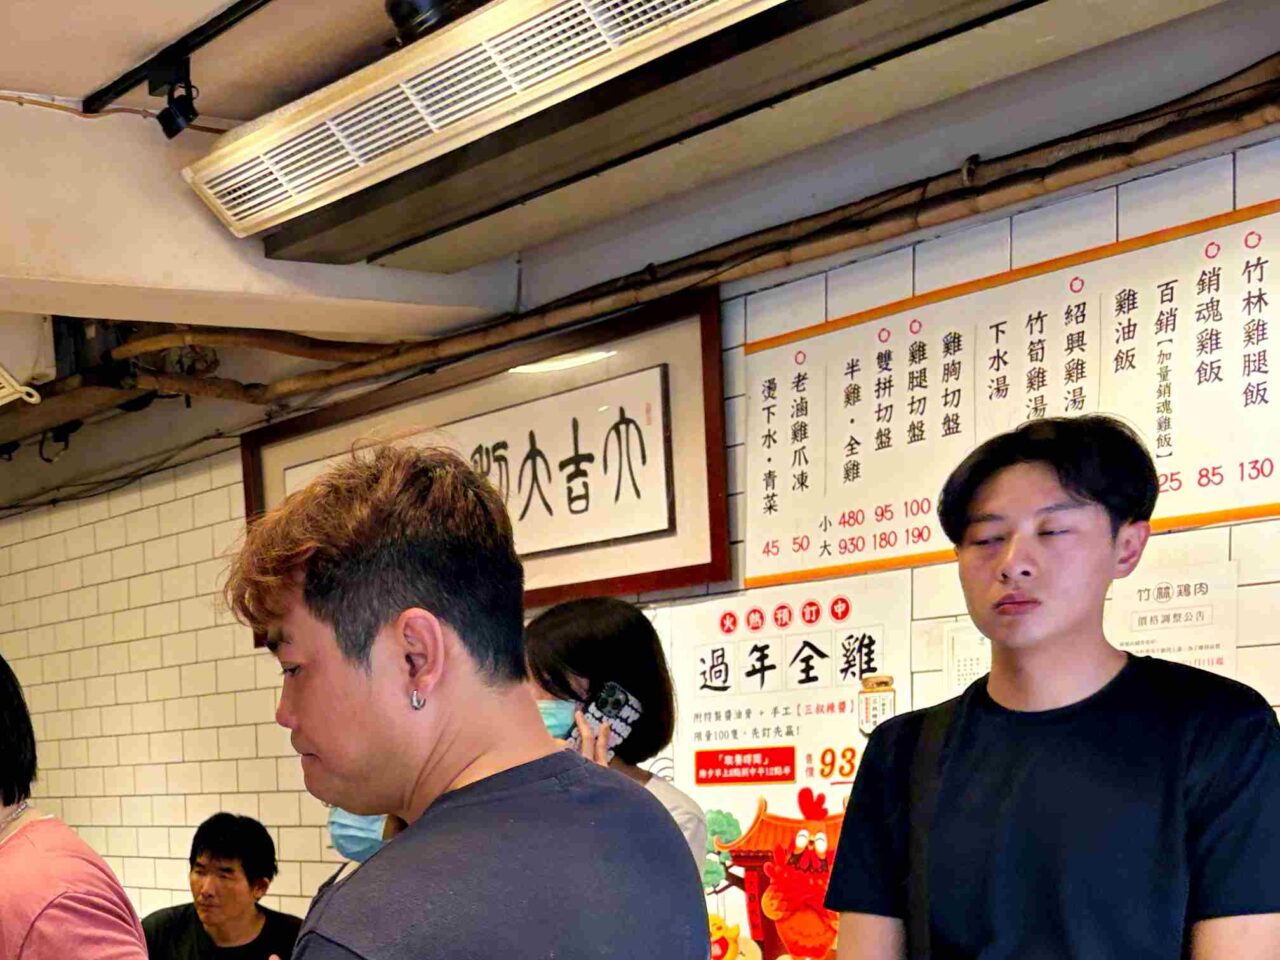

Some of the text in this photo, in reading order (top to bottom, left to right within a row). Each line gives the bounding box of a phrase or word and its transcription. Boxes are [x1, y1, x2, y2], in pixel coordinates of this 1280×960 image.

[987, 320, 1010, 401] 下水湯
[1025, 310, 1048, 420] 竹筍雞湯
[1063, 301, 1088, 413] 紹興雞湯
[1113, 287, 1139, 374] 雞油飯
[1195, 266, 1224, 386] 銷魂雞飯
[1241, 256, 1269, 408] 竹林雞腿飯
[874, 349, 895, 451] 雙拼切盤
[906, 340, 929, 445] 雞腿切盤
[941, 330, 964, 438] 雞胸切盤
[790, 371, 810, 493] 老滷雞爪凍
[1239, 458, 1274, 481] 130
[819, 498, 931, 532] 小 480 95 100
[1197, 465, 1224, 487] 85
[762, 540, 780, 557] 45
[792, 535, 810, 553] 50
[819, 525, 931, 557] 大 930 180 190
[721, 600, 849, 633] 火熱預訂中
[698, 632, 878, 692] 過年全雞
